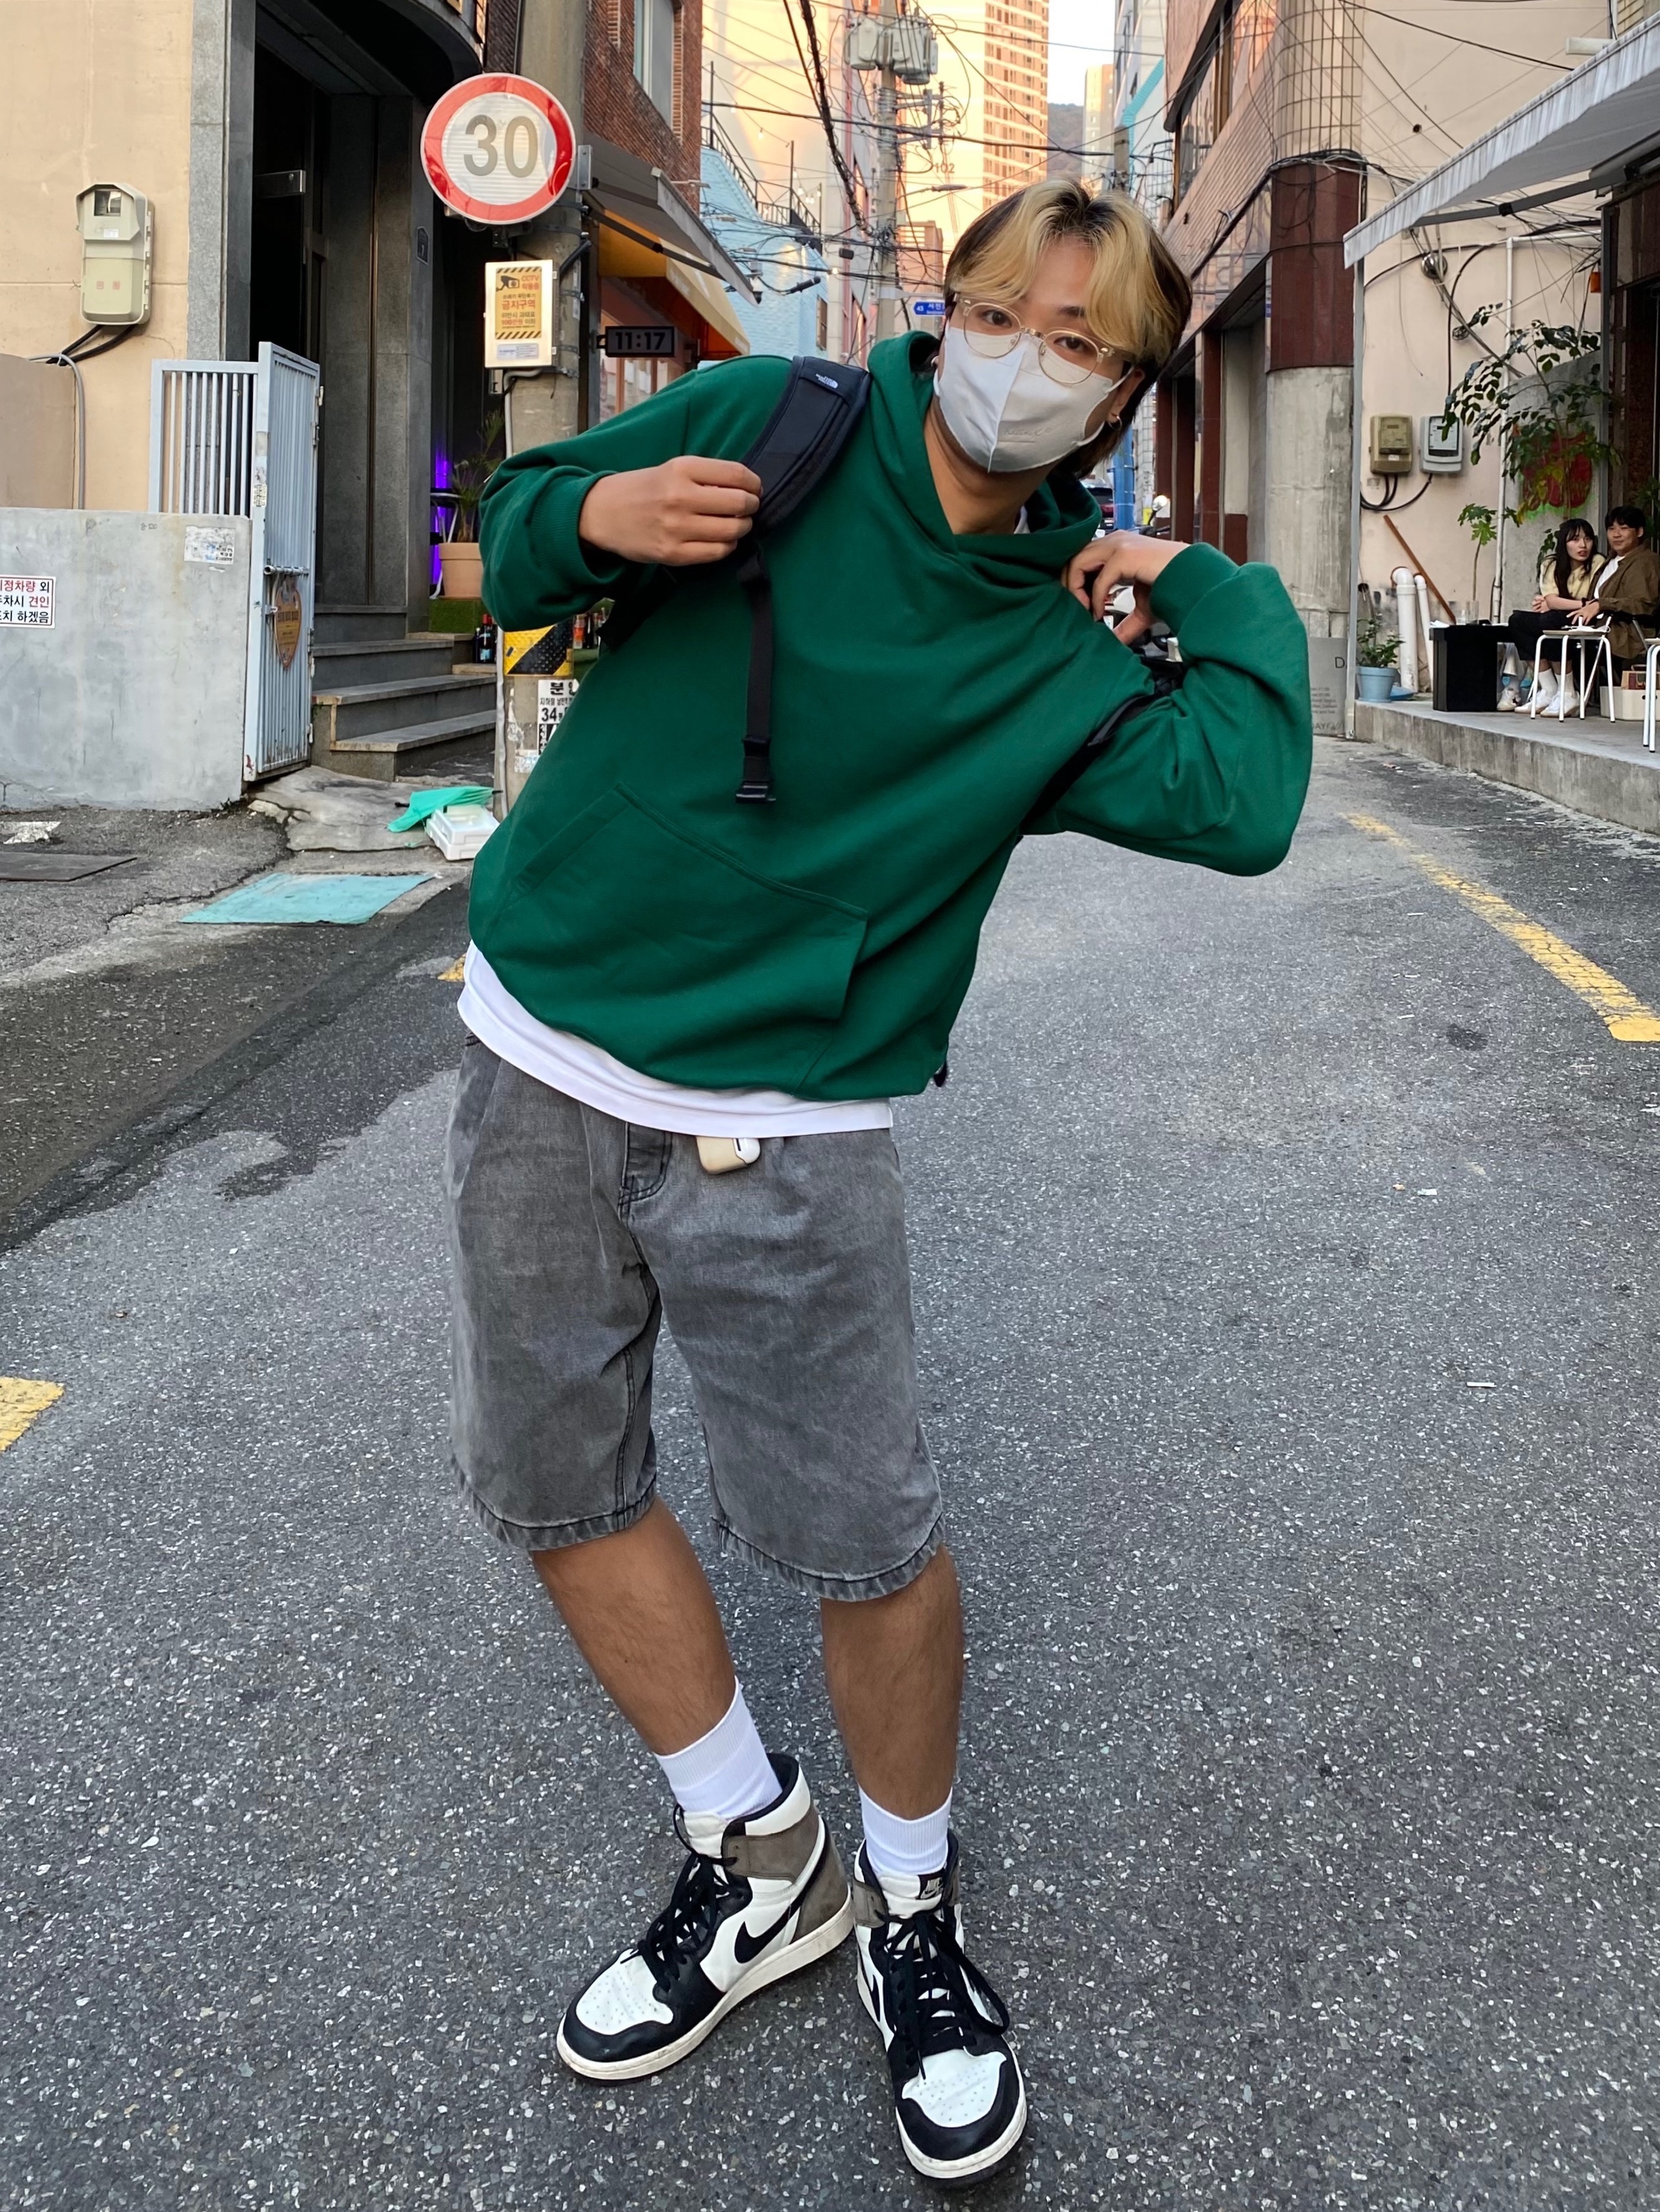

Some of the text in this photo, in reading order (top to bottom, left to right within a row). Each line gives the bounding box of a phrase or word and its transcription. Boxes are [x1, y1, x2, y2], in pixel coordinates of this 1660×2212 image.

[463, 114, 538, 178] 30
[935, 163, 955, 173] 102
[502, 300, 535, 310] 금지구역
[615, 332, 666, 350] 11:17
[40, 581, 49, 594] 외
[29, 596, 49, 608] 견인
[17, 611, 49, 624] 하겠음
